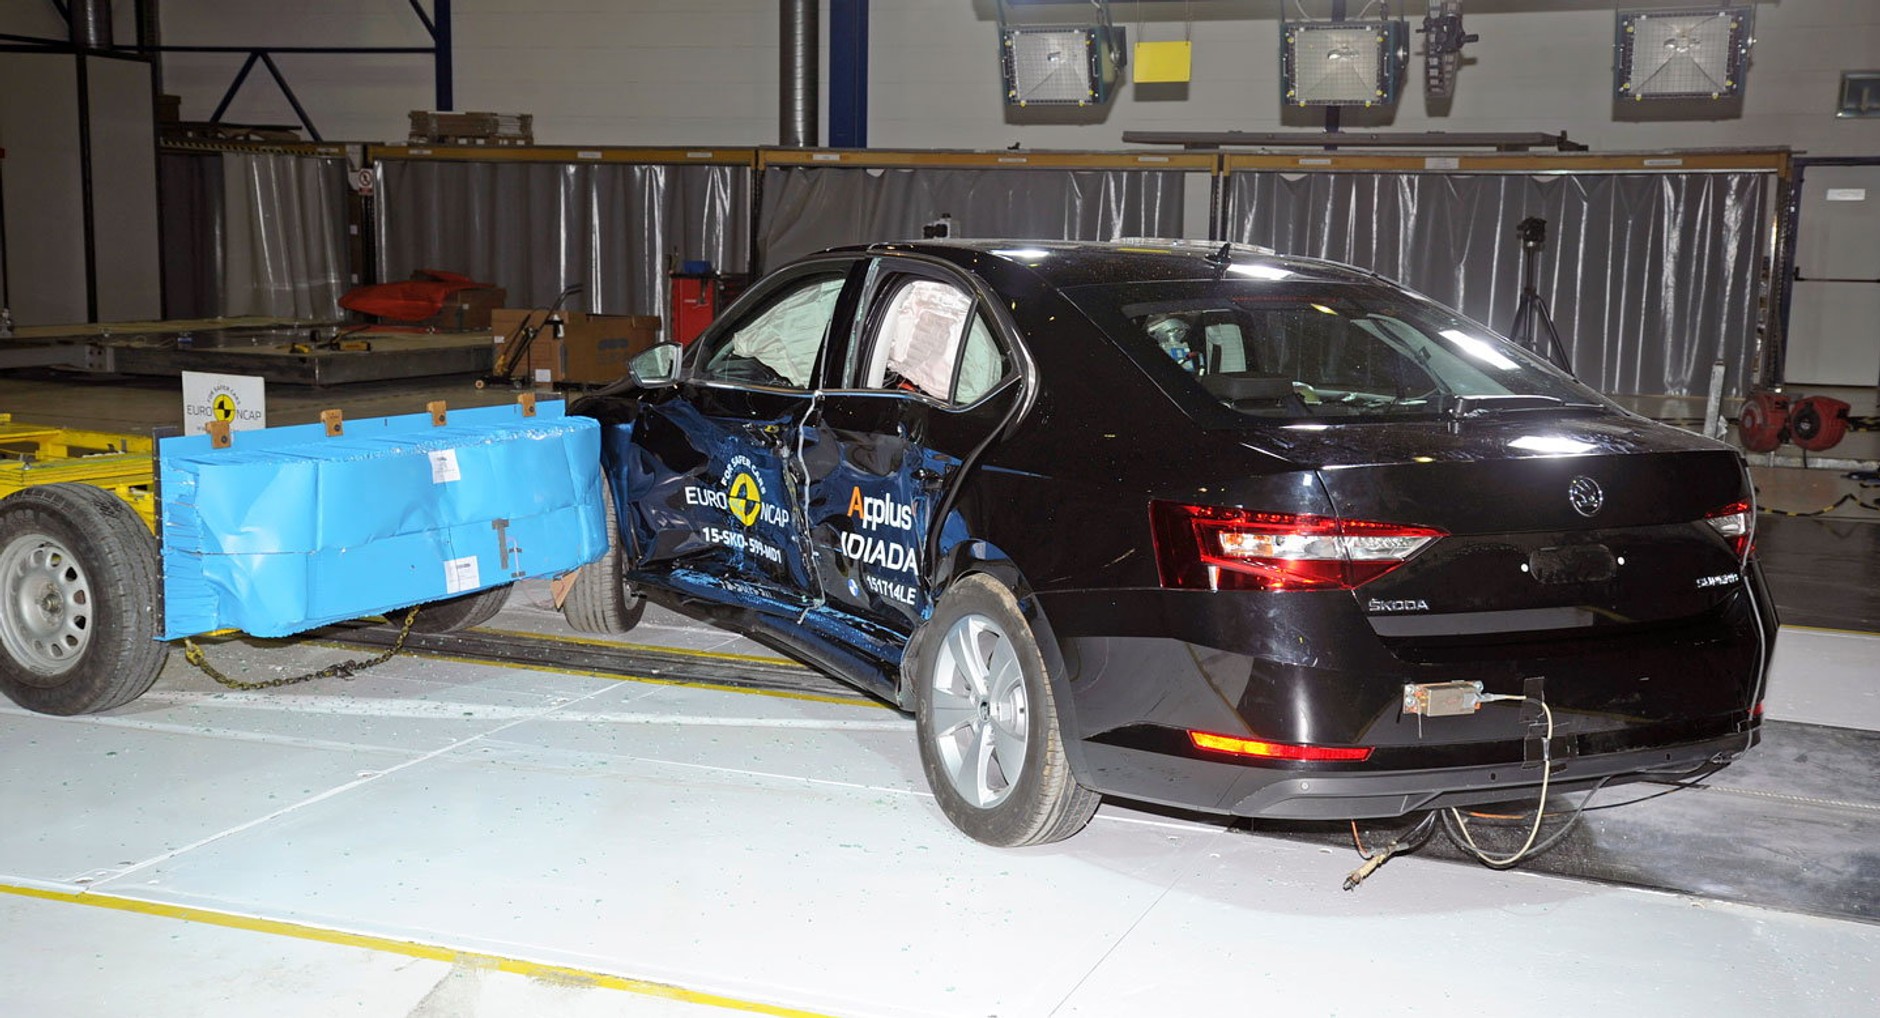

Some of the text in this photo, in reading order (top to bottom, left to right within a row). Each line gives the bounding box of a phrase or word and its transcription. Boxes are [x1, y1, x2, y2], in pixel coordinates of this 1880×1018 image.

[187, 405, 262, 421] EURO NCAP
[720, 454, 767, 495] FOR SAFER CARS
[684, 486, 789, 528] EURO NCAP
[847, 486, 912, 531] Applus
[841, 531, 919, 576] IDIADA
[1368, 598, 1430, 611] ŠKODA
